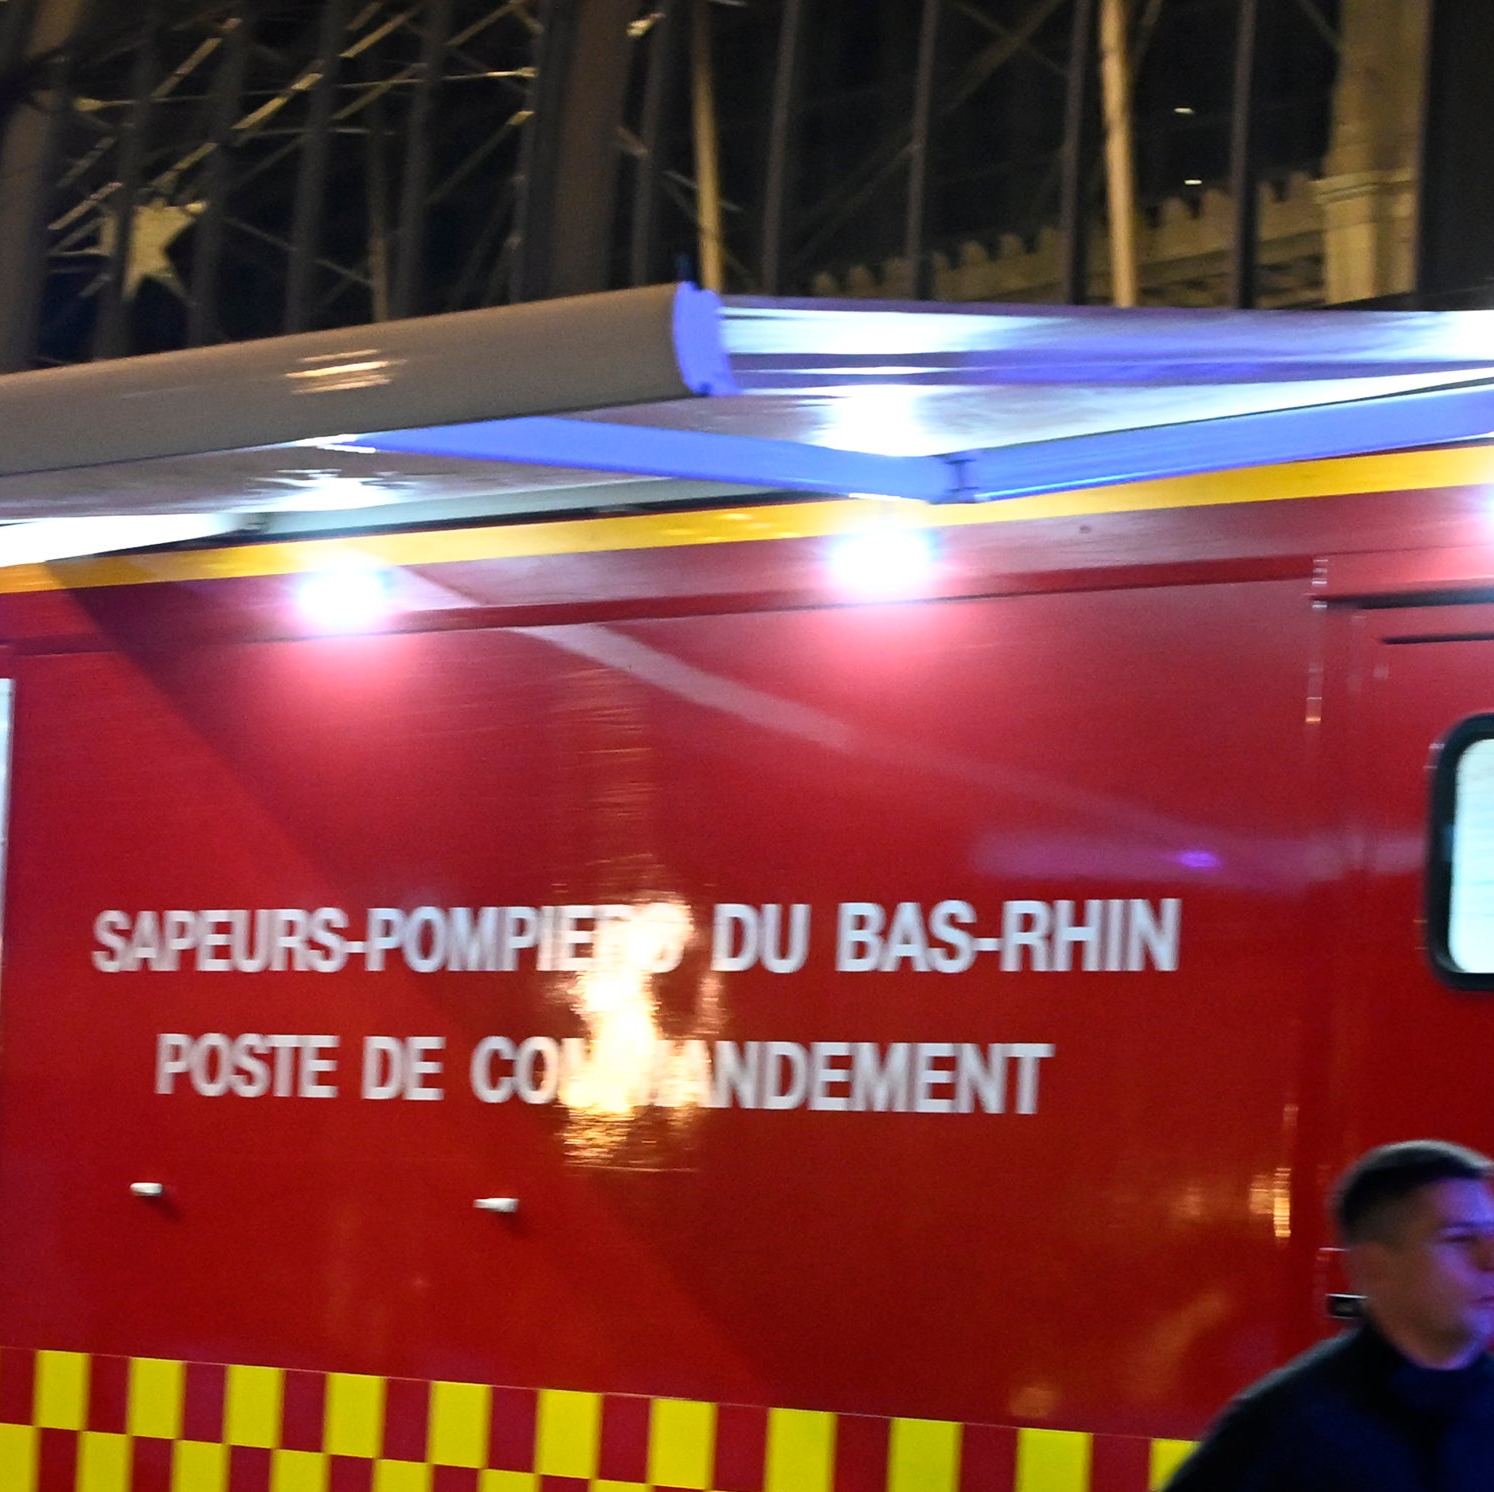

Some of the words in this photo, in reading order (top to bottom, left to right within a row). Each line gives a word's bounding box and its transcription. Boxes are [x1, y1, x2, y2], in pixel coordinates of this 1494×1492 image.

[93, 903, 689, 975] SAPEURS-POMPIE
[711, 902, 811, 974] DU
[835, 897, 1182, 974] BAS-RHIN
[153, 1031, 340, 1100] POSTE
[360, 1035, 445, 1104] DE
[469, 1036, 1055, 1116] COANDEMENT
